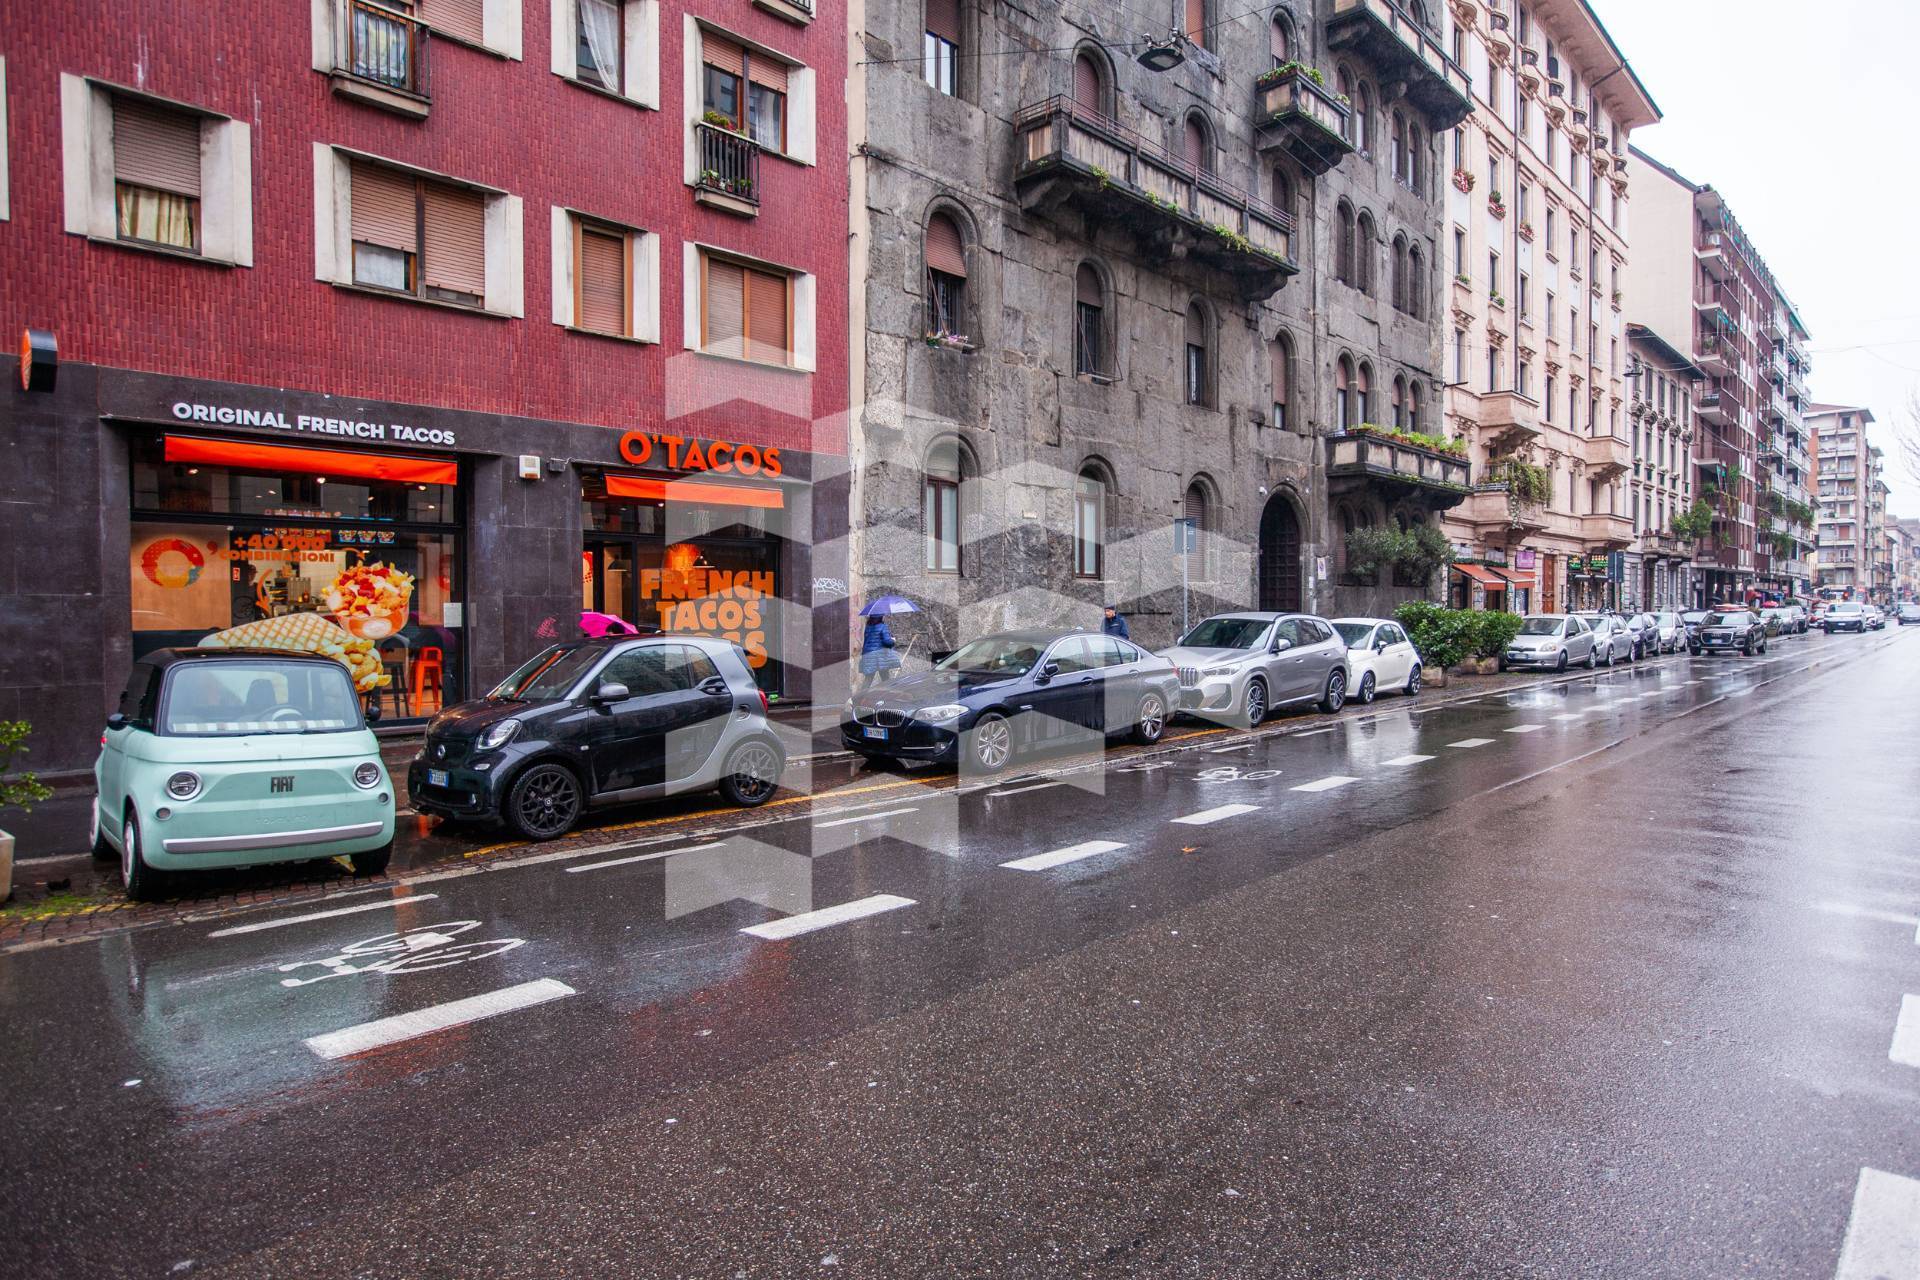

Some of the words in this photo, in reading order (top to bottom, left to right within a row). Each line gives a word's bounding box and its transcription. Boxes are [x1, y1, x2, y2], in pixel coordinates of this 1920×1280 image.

[172, 402, 292, 429] ORIGINAL
[297, 414, 385, 439] FRENCH
[391, 424, 456, 445] TACOS
[619, 430, 783, 479] O'TACOS
[219, 549, 335, 563] COMBINAZIONI
[640, 568, 775, 600] FRENCH
[656, 600, 762, 631] TACOS
[270, 776, 295, 793] FIAT
